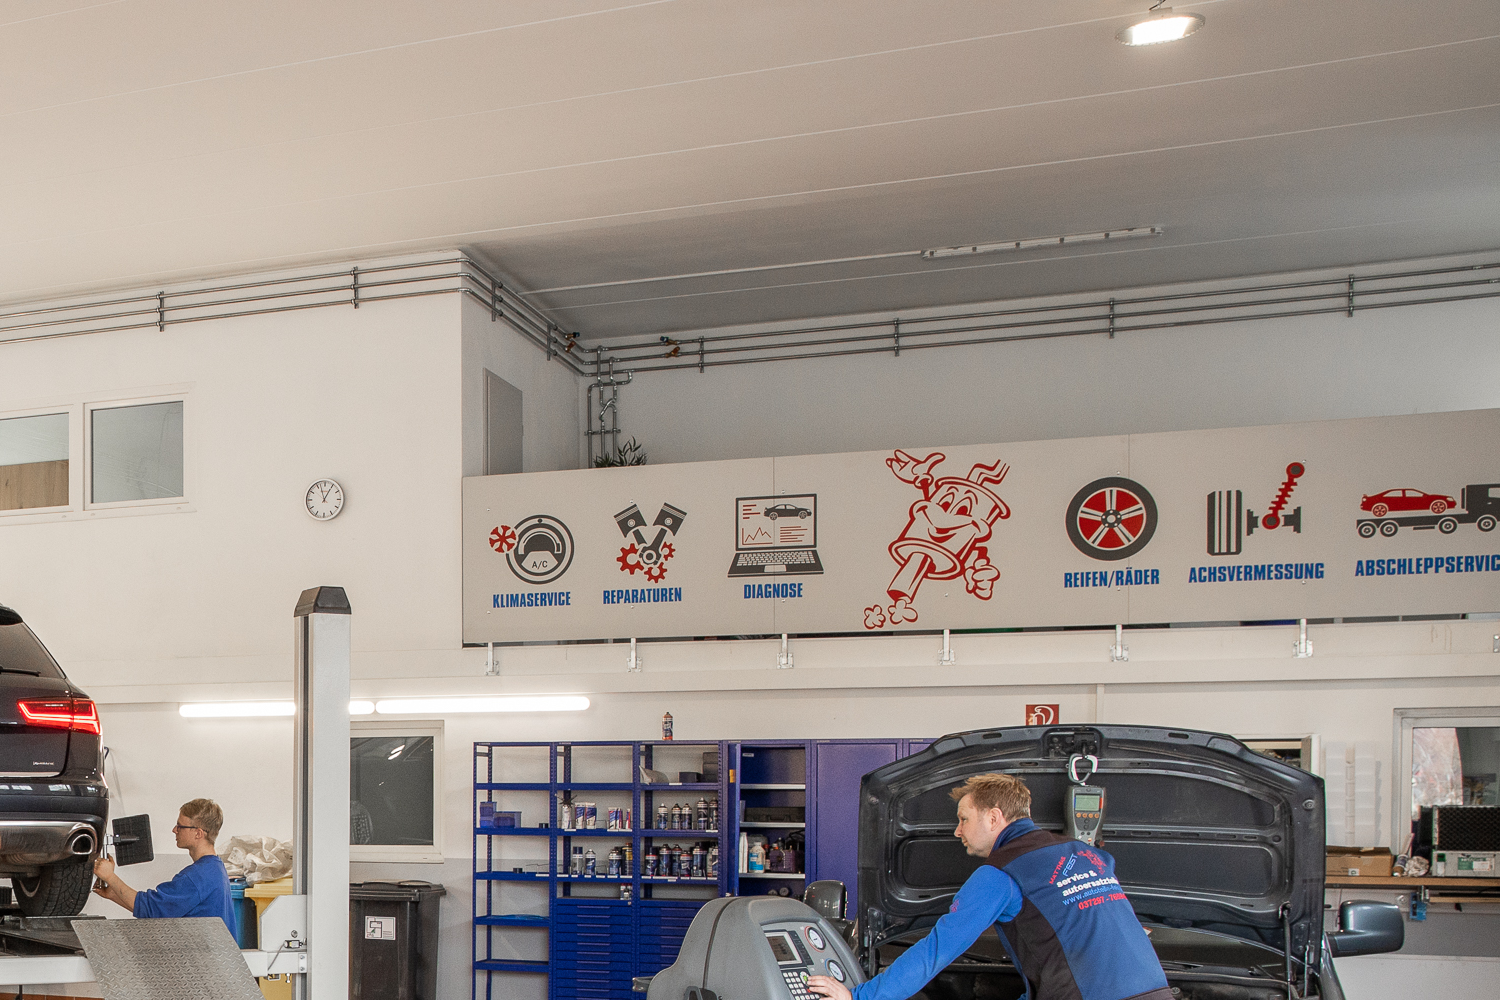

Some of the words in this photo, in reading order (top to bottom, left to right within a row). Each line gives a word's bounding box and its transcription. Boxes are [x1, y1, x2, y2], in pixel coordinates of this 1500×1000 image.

[531, 560, 548, 569] A/C
[1188, 562, 1325, 583] ACHSVERMESSUNG
[1064, 567, 1160, 588] REIFEN/RÄDER
[492, 591, 571, 608] KLIMASERVICE
[602, 587, 682, 604] REPARATUREN
[743, 583, 803, 599] DIAGNOSE
[1056, 871, 1090, 888] service
[1088, 869, 1098, 877] &
